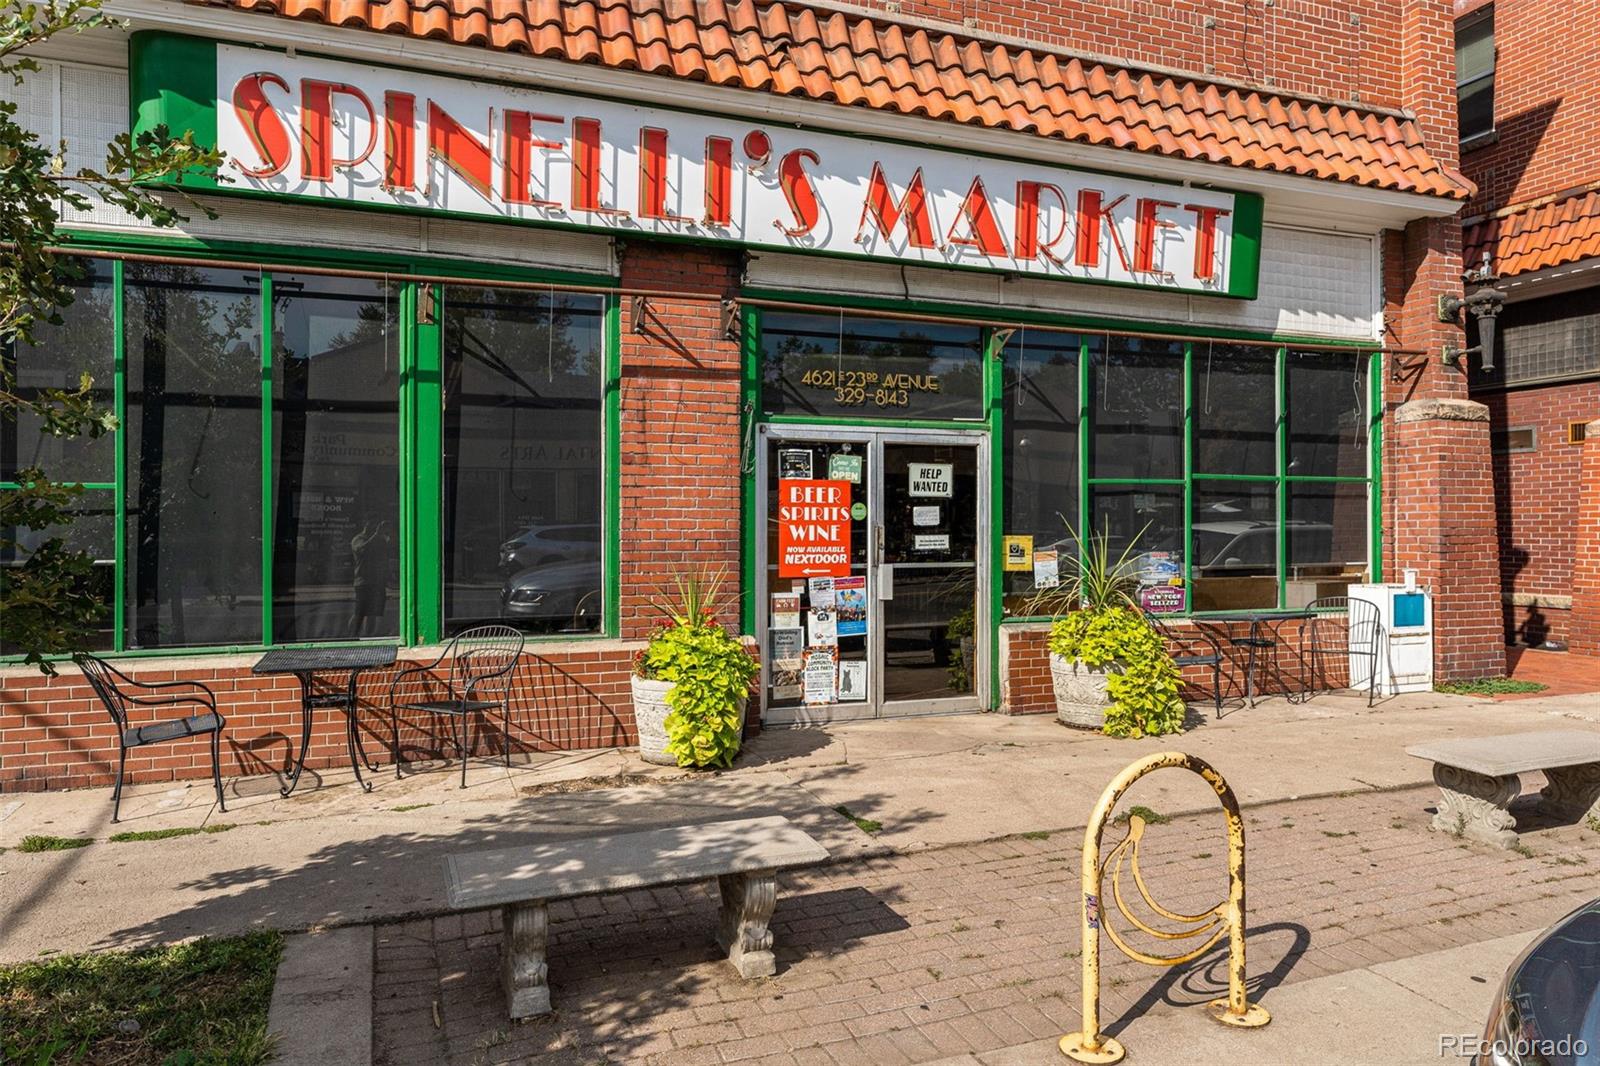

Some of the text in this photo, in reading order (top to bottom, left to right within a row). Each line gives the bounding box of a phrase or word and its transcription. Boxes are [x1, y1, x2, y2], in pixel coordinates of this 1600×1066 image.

[229, 71, 1231, 285] SPINELLI'S MARKET
[801, 370, 836, 386] 4621
[882, 374, 938, 390] AVENUE
[834, 387, 908, 405] 329-8143
[832, 470, 859, 481] OPEN
[920, 468, 942, 480] HELP
[790, 486, 842, 503] BEER
[913, 481, 949, 493] WANTED
[780, 506, 851, 521] SPIRITS
[789, 524, 841, 541] WINE
[784, 554, 848, 565] NEXTDOOR
